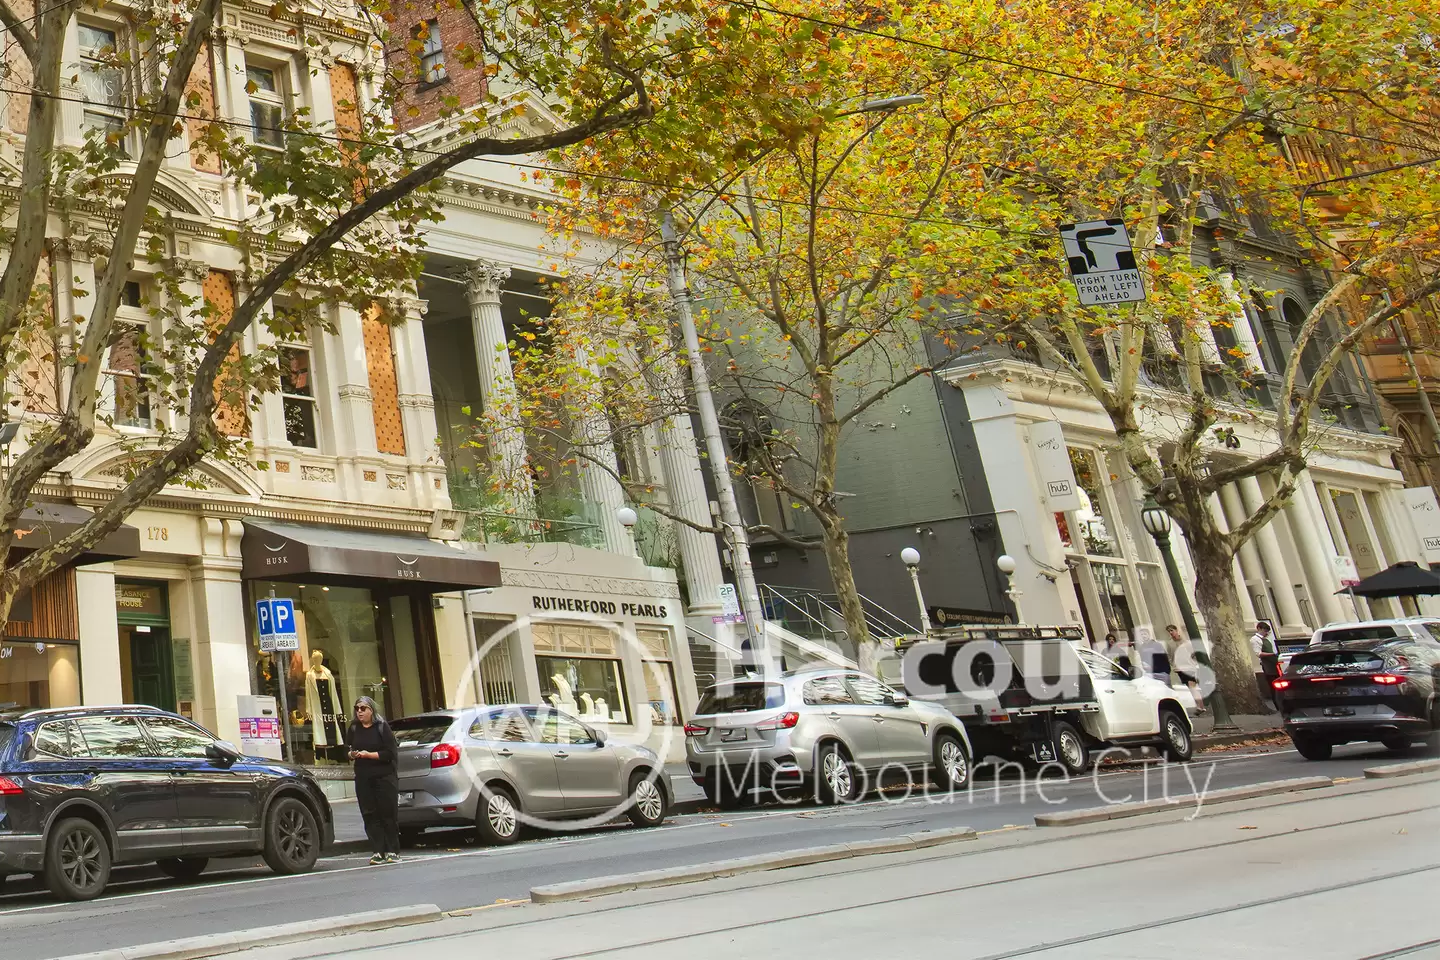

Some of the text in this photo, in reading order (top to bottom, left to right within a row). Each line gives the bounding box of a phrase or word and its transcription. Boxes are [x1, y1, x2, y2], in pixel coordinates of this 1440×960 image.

[1076, 272, 1138, 286] RIGHT TURN
[1080, 281, 1138, 294] FROM LEFT
[1095, 292, 1130, 301] AHEAD
[1050, 484, 1069, 493] hub
[147, 527, 168, 541] 178
[266, 556, 289, 565] HUSK
[397, 570, 422, 579] HUSK
[720, 587, 734, 596] 2P
[119, 600, 143, 608] HOUSE
[532, 596, 668, 618] RUTHERFORD PEARLS
[276, 605, 289, 629] P
